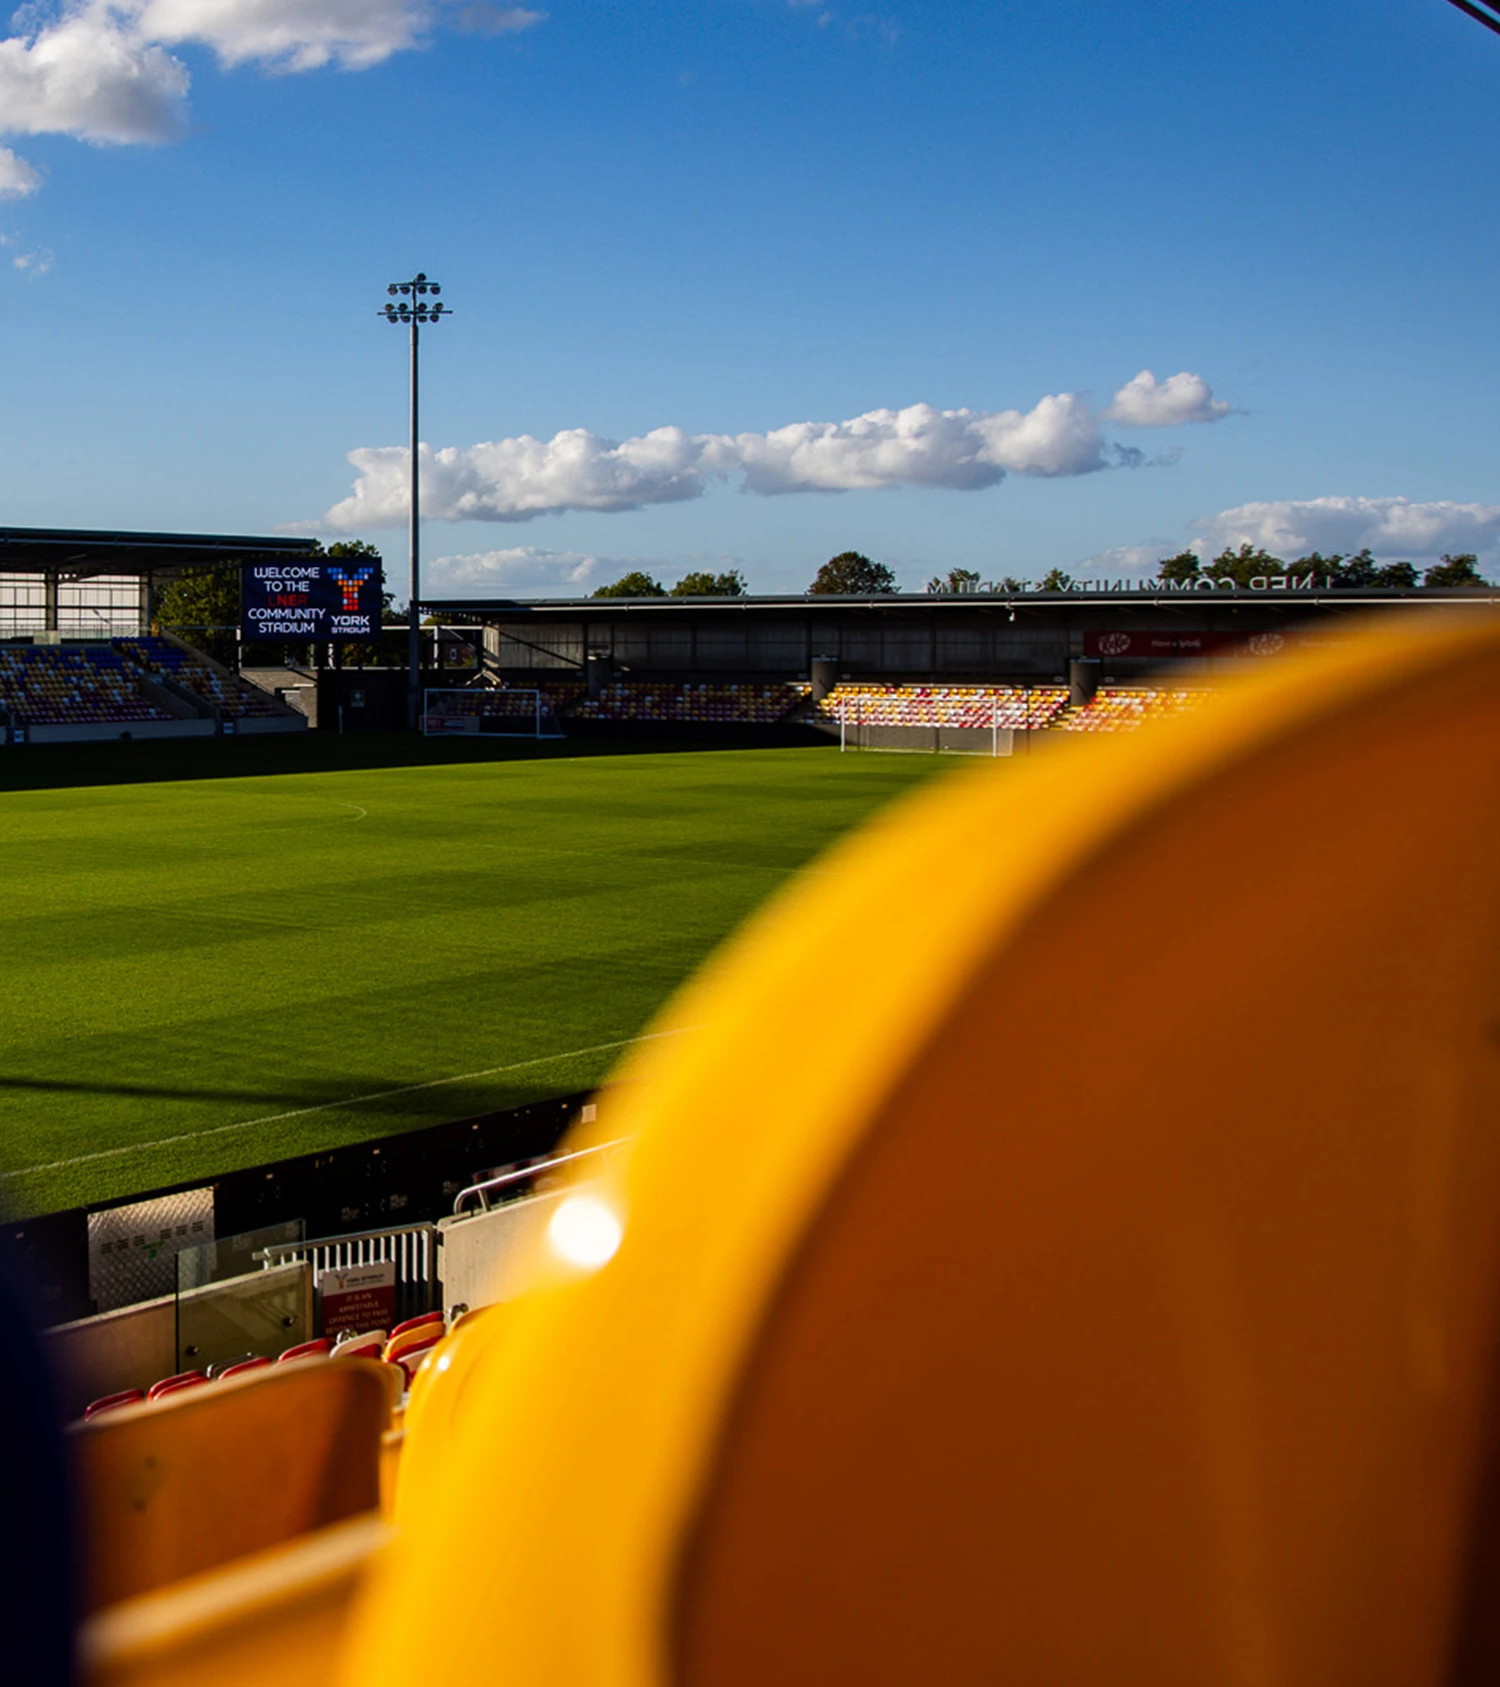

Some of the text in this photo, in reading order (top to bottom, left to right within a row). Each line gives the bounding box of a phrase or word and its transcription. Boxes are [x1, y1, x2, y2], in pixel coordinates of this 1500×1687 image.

[254, 567, 320, 579] WELCOME
[264, 581, 310, 592] TO THE
[268, 594, 308, 607] LNER
[248, 608, 326, 619] COMMUNITY
[331, 616, 370, 625] YORK
[259, 622, 315, 633] STADIUM
